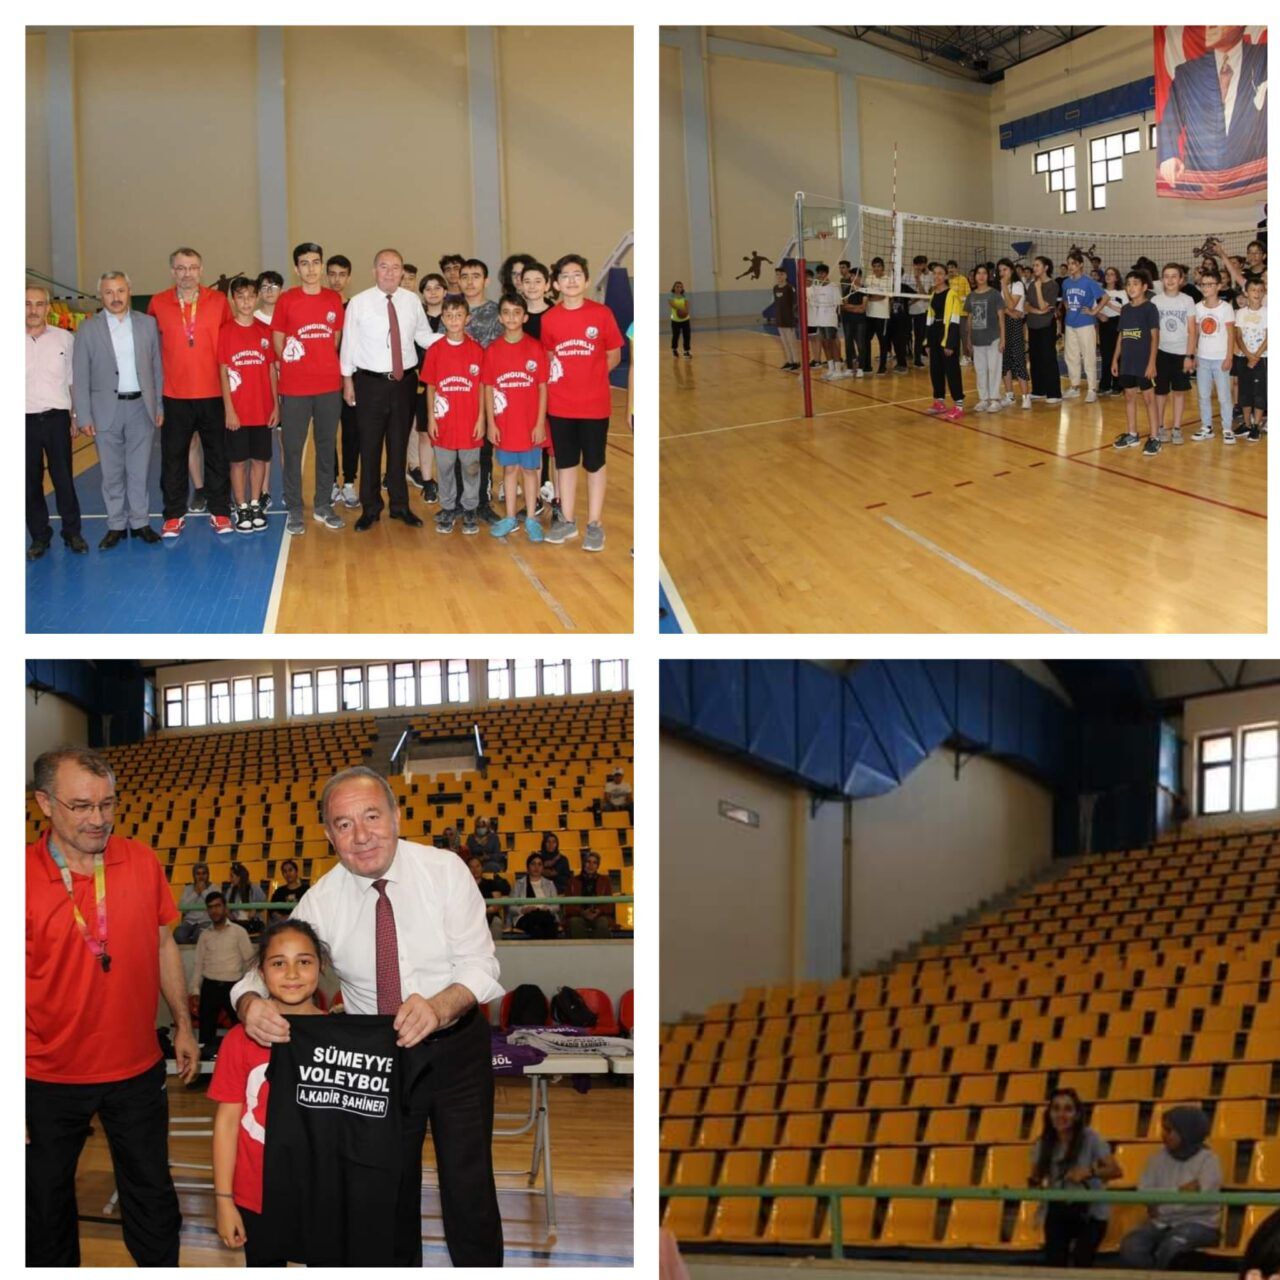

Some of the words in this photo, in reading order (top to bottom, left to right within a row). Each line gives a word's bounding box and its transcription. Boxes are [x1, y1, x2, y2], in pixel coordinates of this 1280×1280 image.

[313, 1045, 394, 1073] SÜMEYYE
[299, 1065, 390, 1092] VOLEYBOL
[299, 1089, 340, 1104] A.KADİR
[342, 1095, 385, 1113] ŞAHİNER
